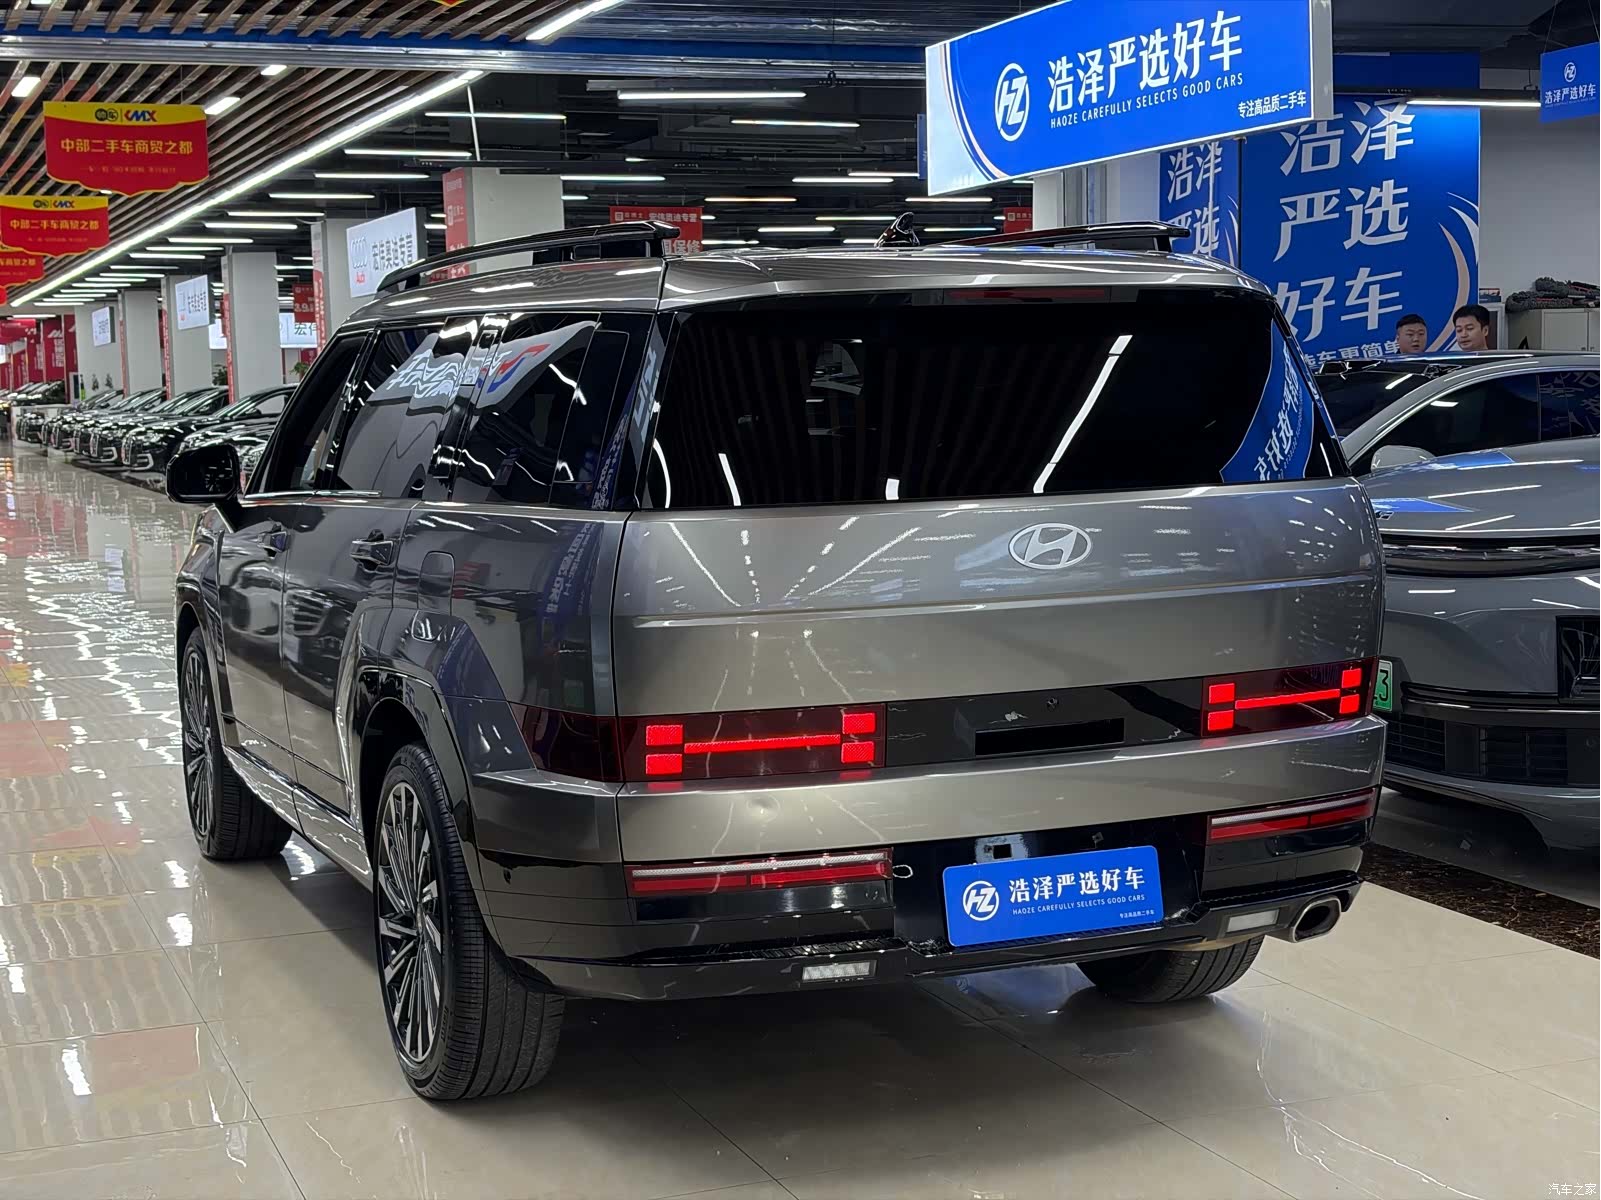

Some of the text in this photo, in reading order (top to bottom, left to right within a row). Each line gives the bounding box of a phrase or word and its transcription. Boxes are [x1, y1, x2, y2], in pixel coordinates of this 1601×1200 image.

[1047, 10, 1242, 113] 浩泽严选好车
[1050, 73, 1244, 129] HAOZE CAREFULLY SELECTS GOOD CARS
[1237, 90, 1307, 119] 专注高品质二手车
[1545, 83, 1597, 105] 浩泽严选好车
[60, 138, 193, 155] 中部二手车商贸之都
[1280, 98, 1415, 176] 浩泽
[1167, 142, 1223, 204] 浩泽
[9, 218, 100, 231] 中部二手车商贸之都
[1272, 179, 1410, 262] 严选
[1273, 267, 1403, 343] 好车
[1009, 866, 1146, 904] 浩泽严选好车
[1012, 894, 1146, 915] HAOZE CAREFULLY SELECTS GOOD CARS
